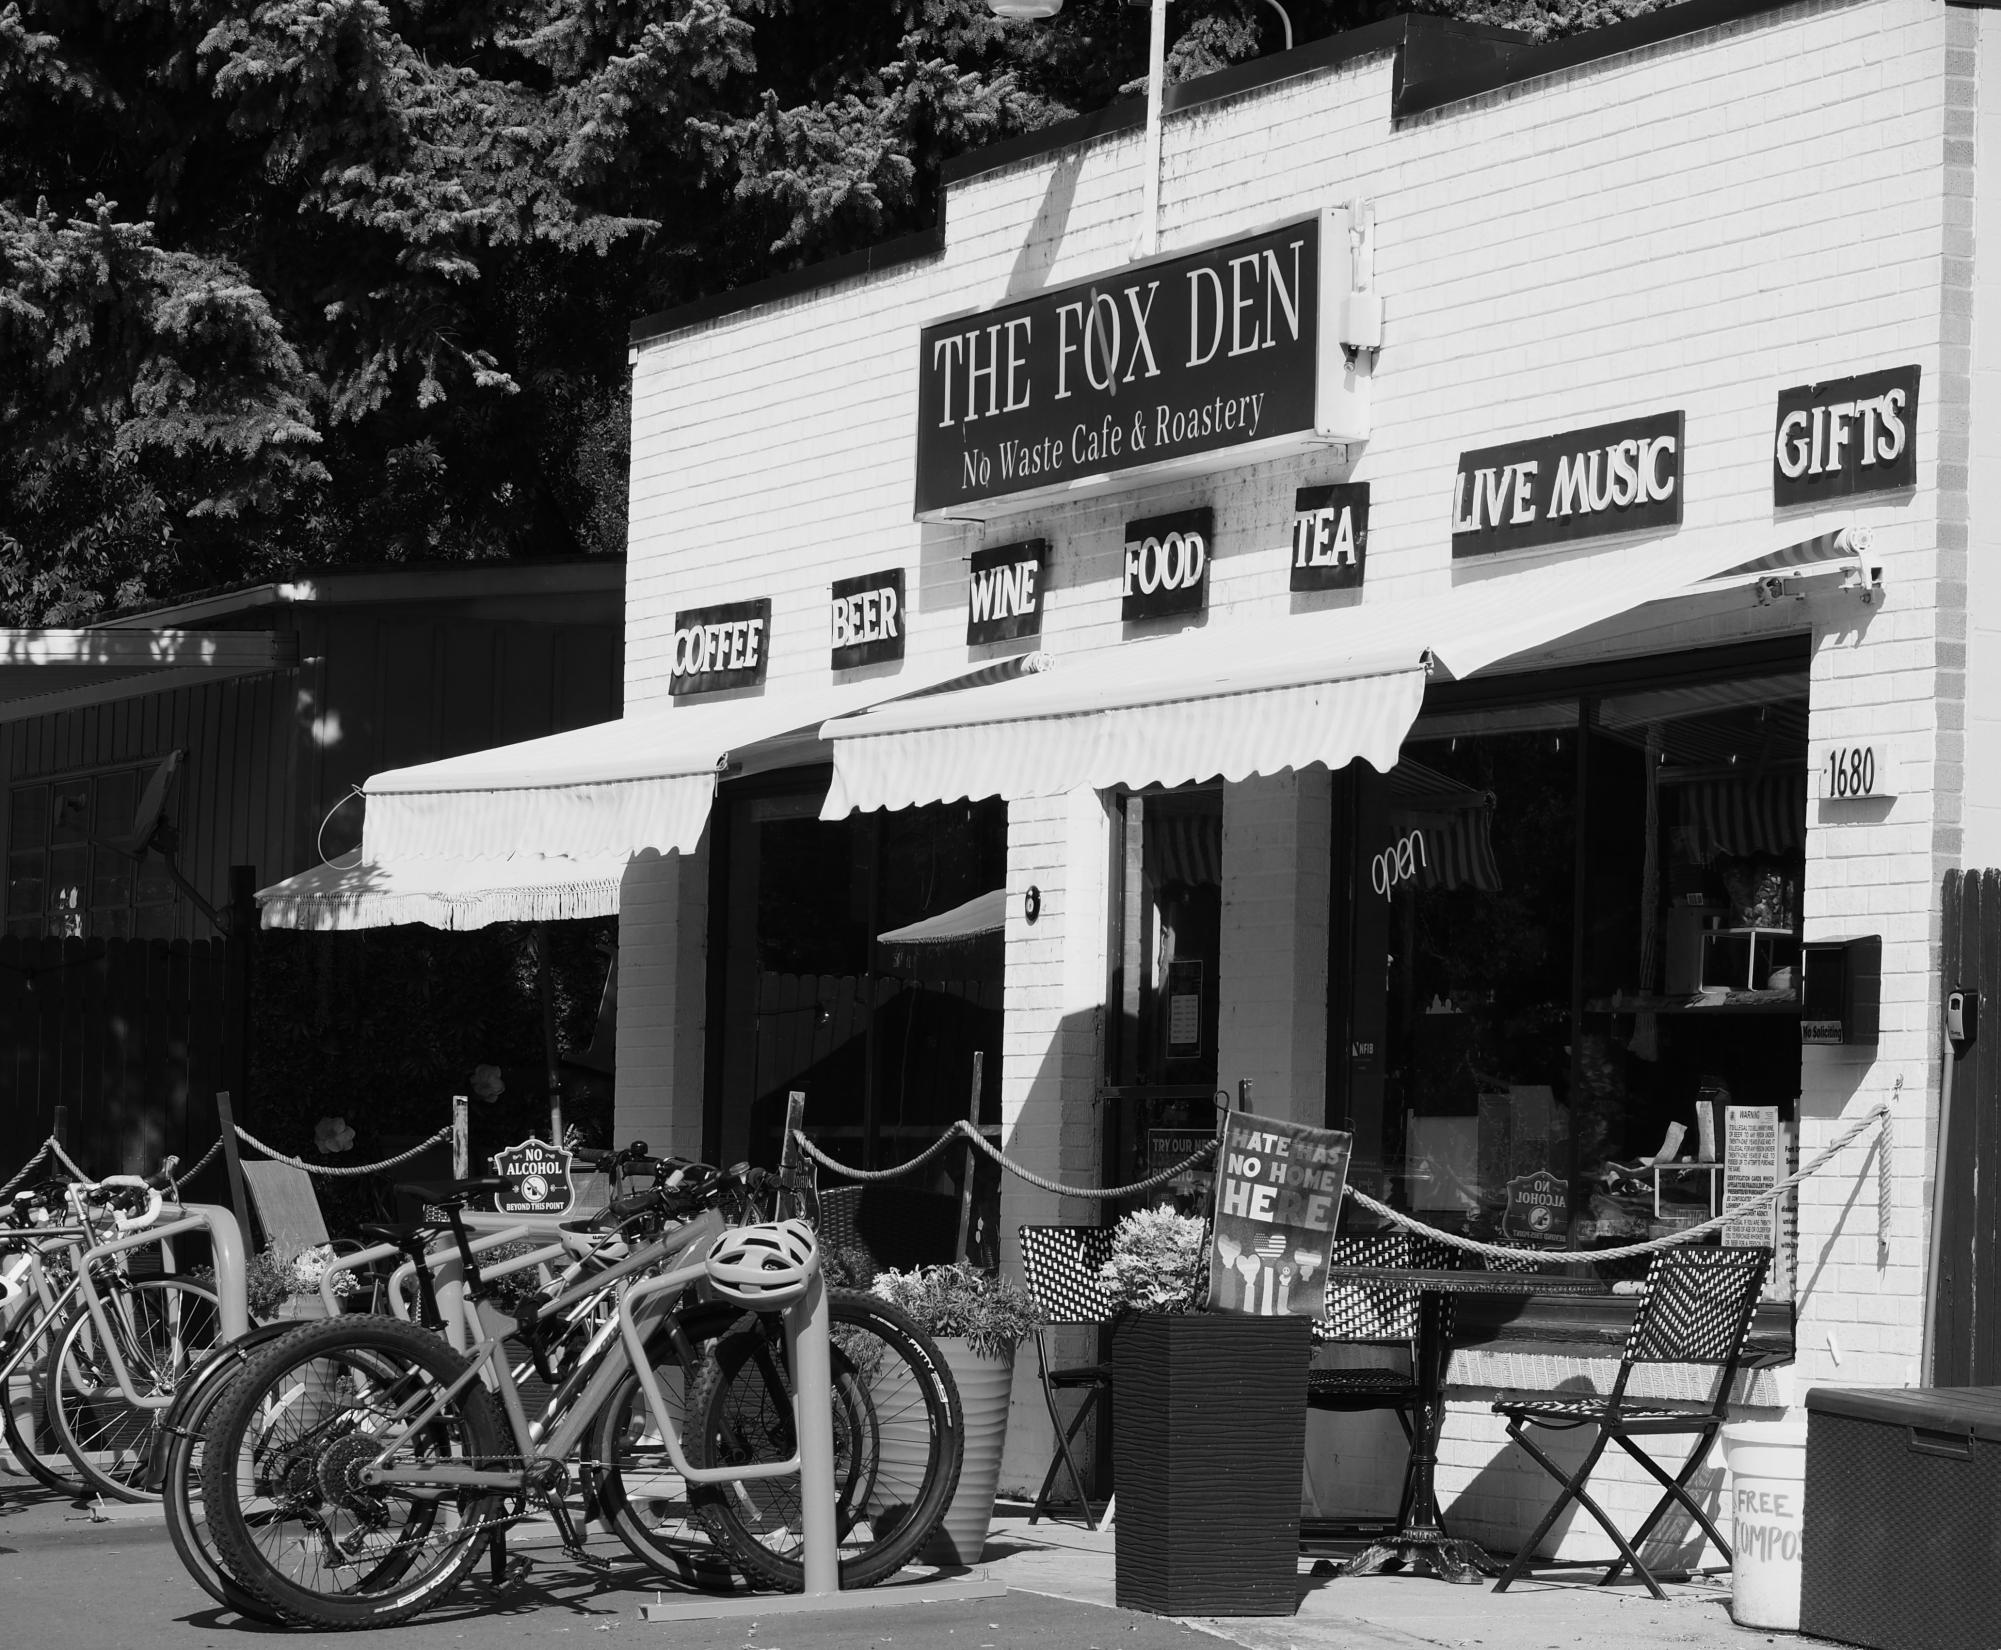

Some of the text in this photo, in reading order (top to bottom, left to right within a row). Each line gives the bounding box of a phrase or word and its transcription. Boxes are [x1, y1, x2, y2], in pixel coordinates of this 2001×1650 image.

[934, 240, 1304, 428] THE FOX DEN
[961, 391, 1265, 490] No Waste Cafe & Roastery
[1776, 388, 1906, 479] GIFTS
[1451, 435, 1676, 534] LIVE MUSIC
[1122, 531, 1204, 597] FOOD
[1293, 507, 1358, 568] TEA
[969, 559, 1038, 624] WINE
[672, 617, 764, 676] COFFEE
[831, 590, 898, 650] BEER
[1829, 746, 1875, 797] 1680
[1371, 829, 1427, 903] open
[1803, 1025, 1842, 1042] No Soliciting
[506, 1162, 562, 1176] ALCOHOL
[525, 1148, 543, 1161] NO
[1152, 1138, 1171, 1152] TRY
[1172, 1138, 1192, 1153] OUR
[1227, 1153, 1262, 1178] NO
[1269, 1161, 1337, 1192] HOME
[1231, 1127, 1340, 1165] HATE HAS
[506, 1202, 565, 1211] BEYOND THIS POINT
[1223, 1178, 1333, 1232] HERE
[1737, 1489, 1794, 1519] FREE
